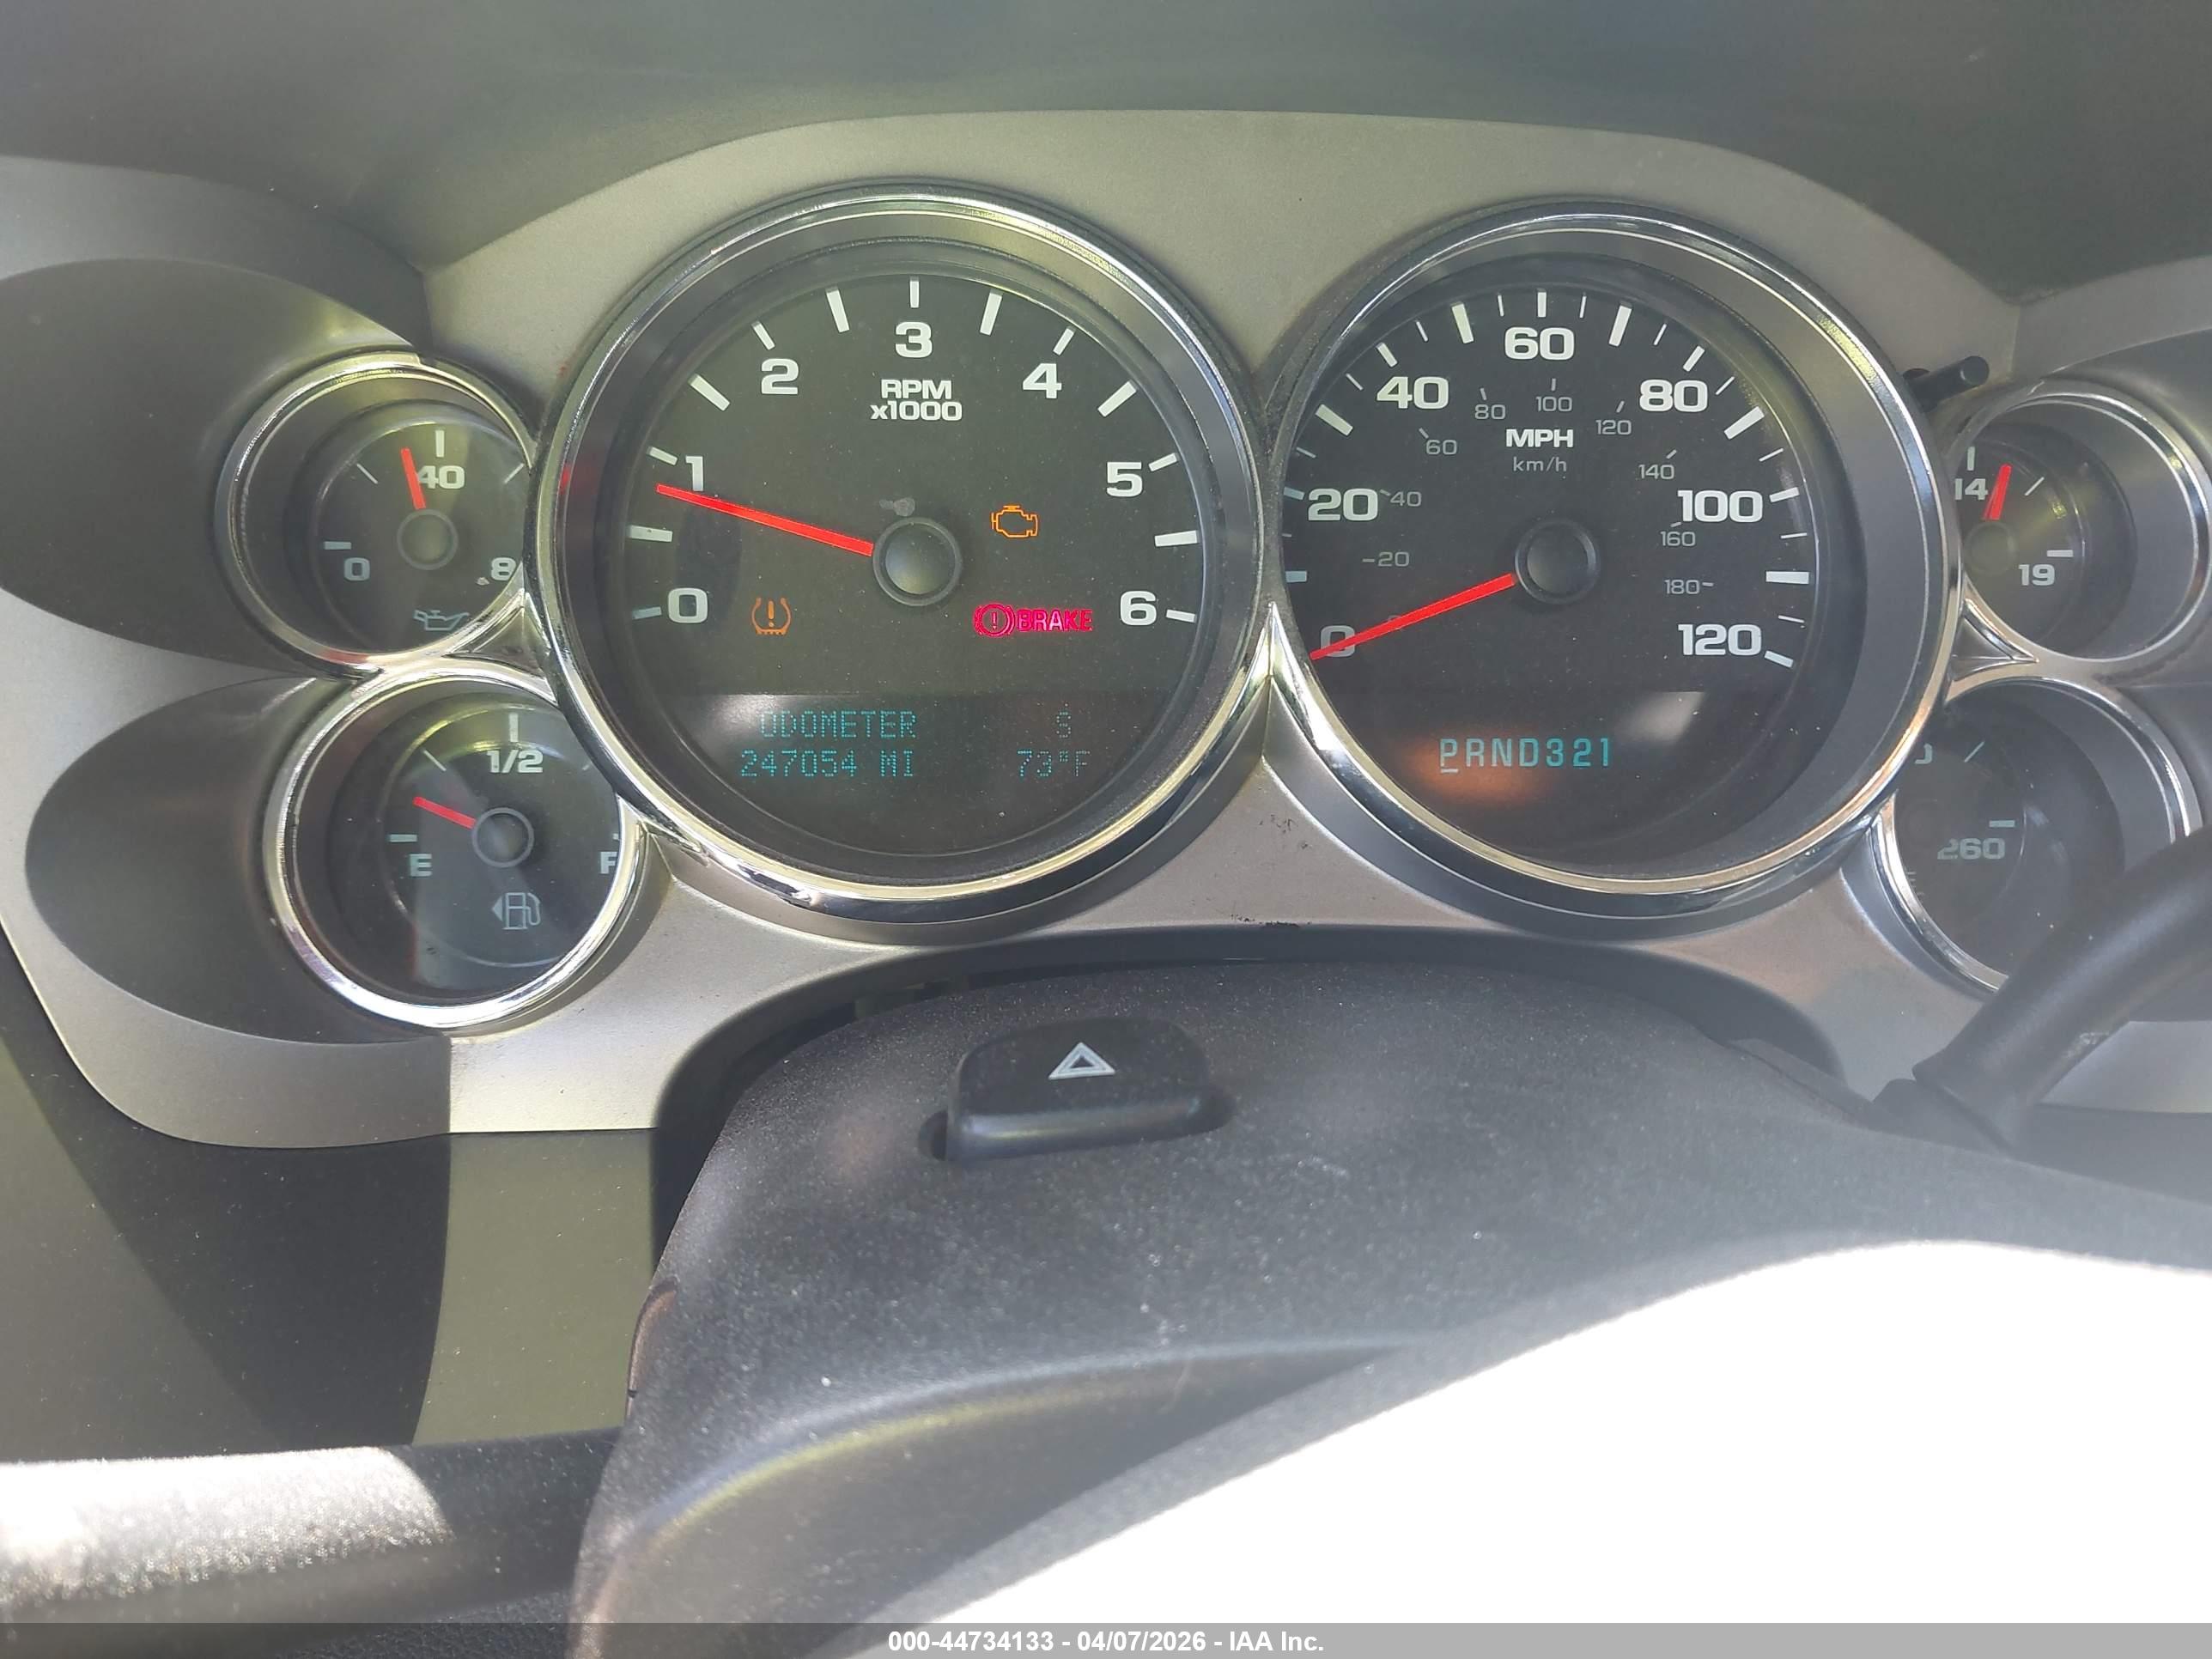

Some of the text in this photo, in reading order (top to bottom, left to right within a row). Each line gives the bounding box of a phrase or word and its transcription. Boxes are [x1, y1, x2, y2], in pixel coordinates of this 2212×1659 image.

[896, 321, 933, 358] 3
[1504, 327, 1575, 361] 60
[760, 358, 799, 395] 2
[1022, 363, 1061, 398] 4
[880, 379, 951, 399] RPM
[1376, 376, 1449, 410] 40
[1639, 380, 1709, 413] 80
[870, 401, 963, 422] x1000
[1474, 404, 1505, 421] 80
[1535, 396, 1572, 413] 100
[1505, 429, 1574, 448] MPH
[1595, 419, 1632, 436] 120
[1425, 439, 1458, 456] 60
[685, 455, 703, 491] 1
[1512, 456, 1567, 473] km/h
[1638, 463, 1674, 481] 140
[418, 465, 465, 489] 40
[1106, 461, 1143, 497] 5
[1954, 477, 1989, 500] 14
[1307, 488, 1378, 521] 20
[1389, 490, 1422, 507] 40
[1677, 489, 1763, 523] 100
[1660, 531, 1696, 547] 160
[345, 557, 370, 581] 0
[1378, 550, 1410, 568] 20
[2019, 563, 2056, 586] 19
[1664, 579, 1701, 596] 180
[667, 587, 708, 623] 0
[1119, 589, 1157, 627] 6
[1016, 608, 1092, 632] BRAKE
[1320, 624, 1356, 658] 0
[1677, 623, 1761, 656] 120
[759, 709, 917, 738] ODOMETER
[1055, 709, 1073, 738] S
[487, 749, 544, 774] 1/2
[740, 749, 915, 777] 247054 MI
[1439, 737, 1609, 769] PRND321
[1937, 837, 2006, 860] 260
[410, 854, 433, 877] E
[600, 851, 617, 874] F
